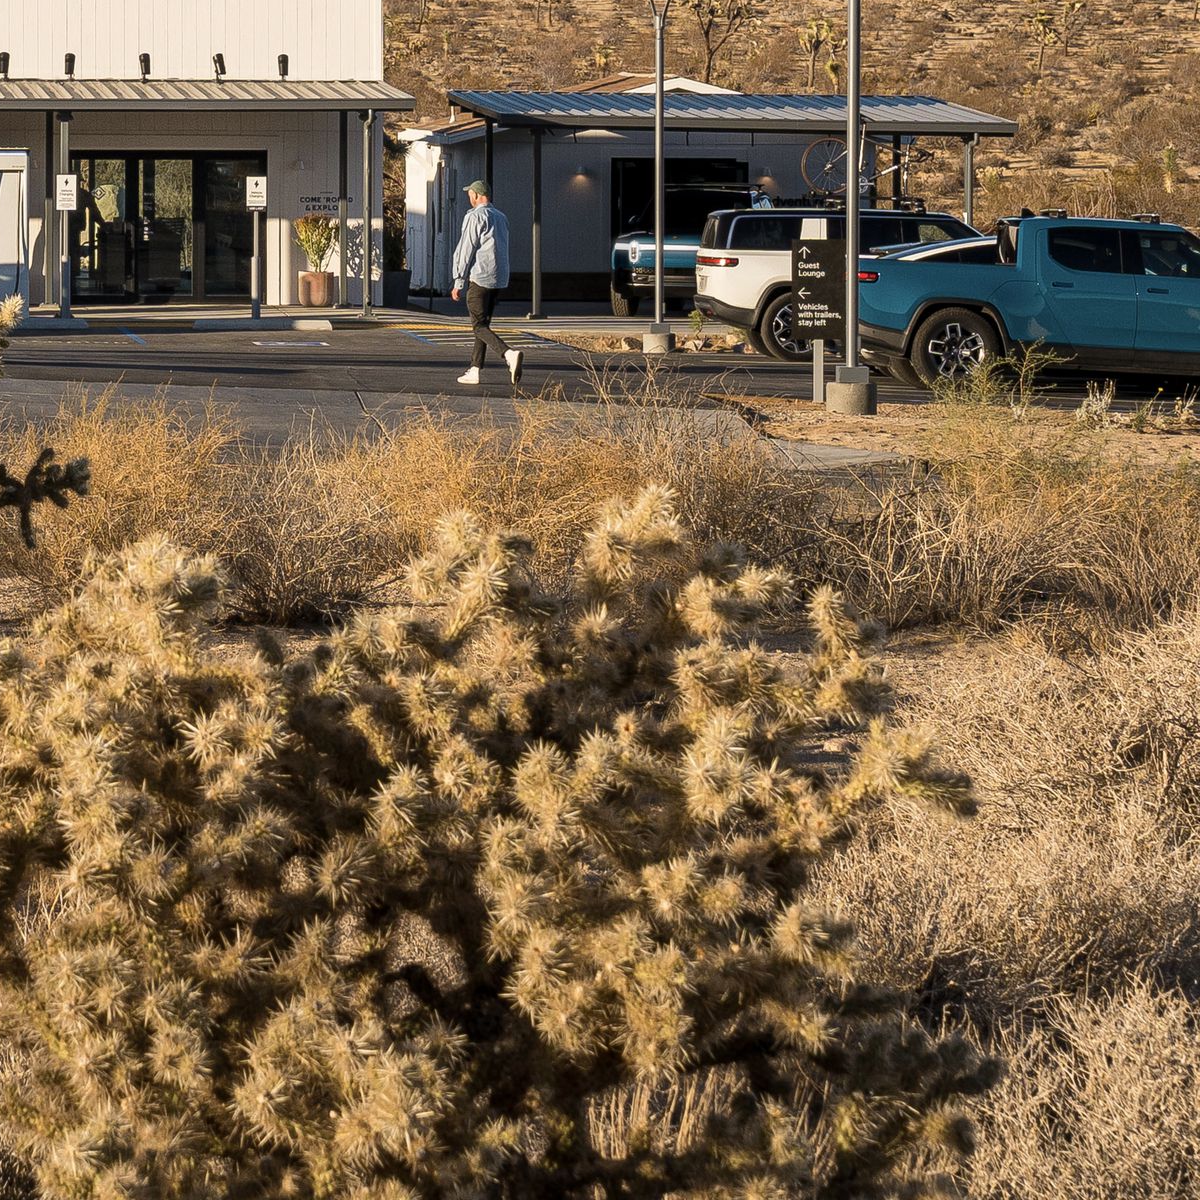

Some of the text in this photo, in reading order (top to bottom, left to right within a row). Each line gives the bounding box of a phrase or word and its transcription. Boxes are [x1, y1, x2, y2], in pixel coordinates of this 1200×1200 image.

[772, 195, 825, 207] dventur
[798, 261, 820, 269] Guest
[798, 270, 826, 279] Lounge
[798, 303, 829, 311] Vehicles
[798, 311, 842, 320] with trailers,
[798, 318, 827, 328] stay left
